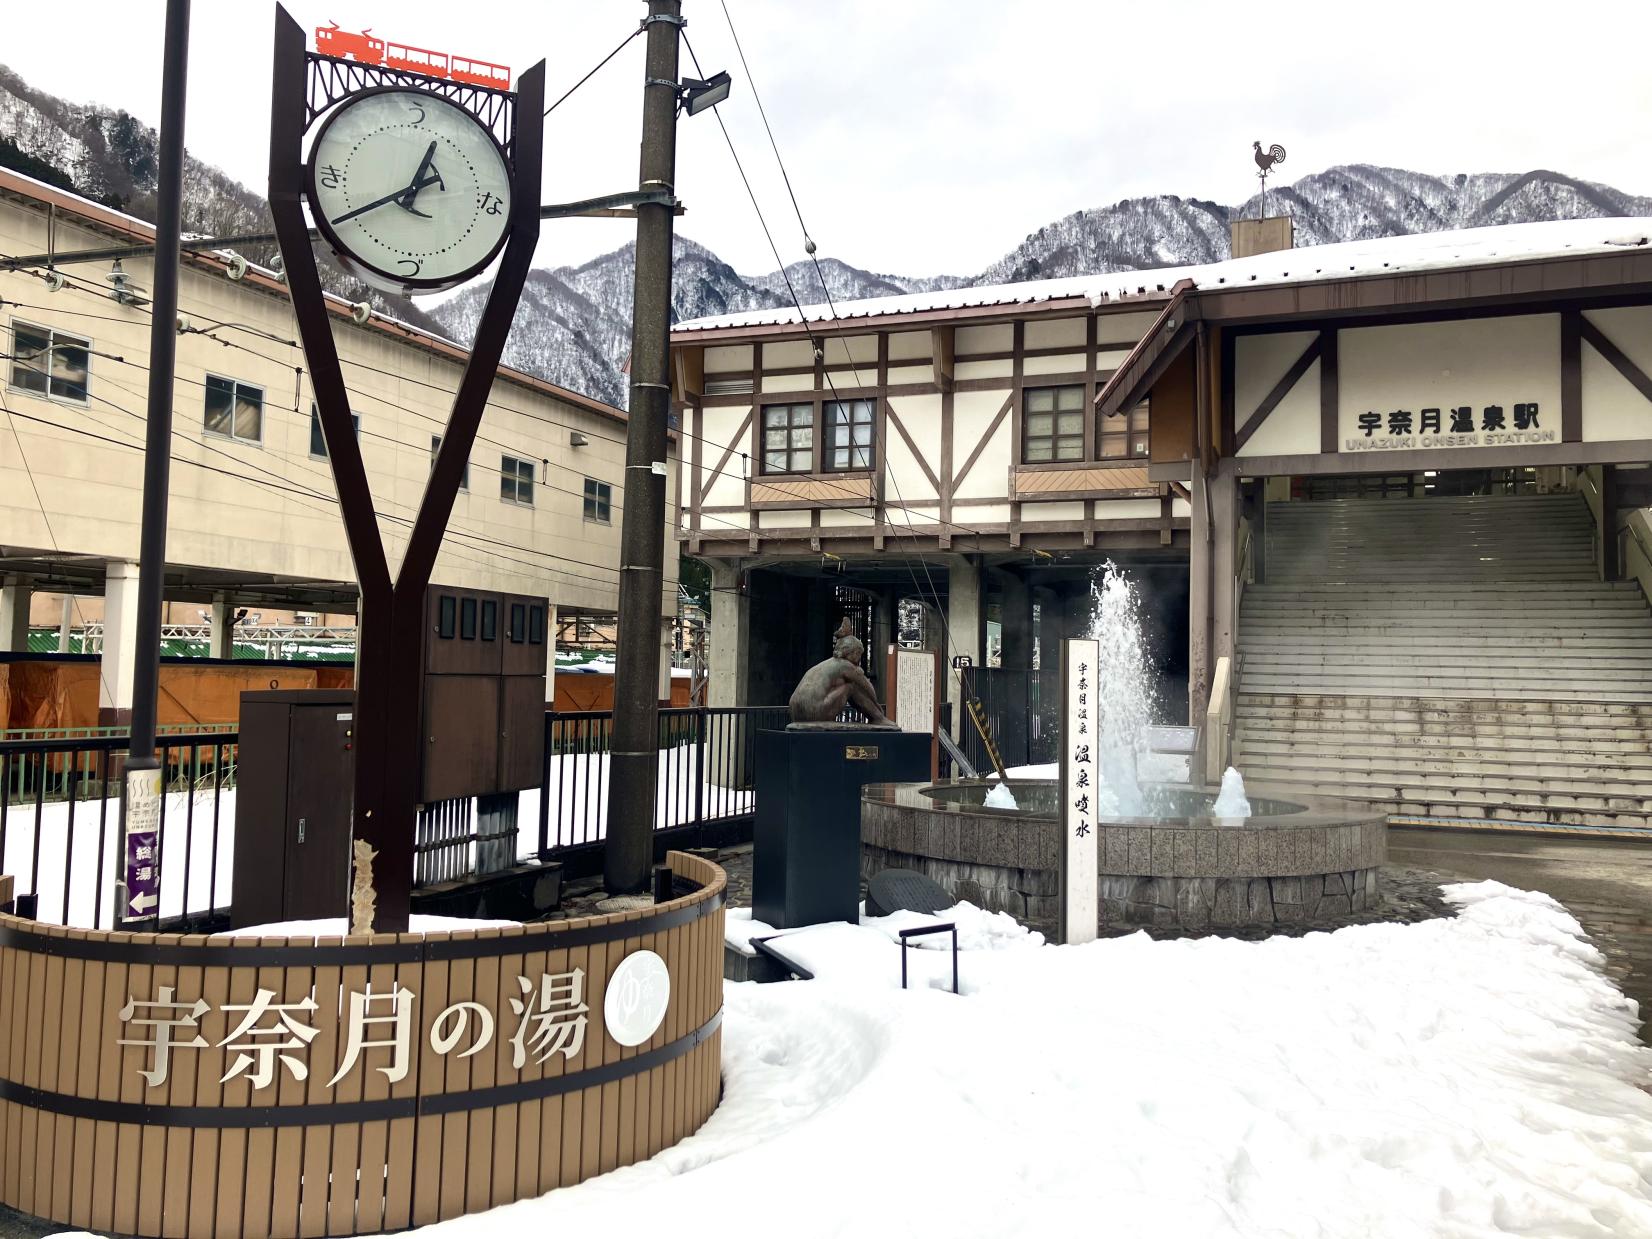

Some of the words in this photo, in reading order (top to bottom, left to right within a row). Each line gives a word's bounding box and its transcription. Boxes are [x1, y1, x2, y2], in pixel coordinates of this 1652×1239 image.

[408, 101, 426, 124] う
[481, 191, 503, 215] な
[397, 258, 423, 277] づ
[1358, 402, 1540, 437] 宇奈月温泉駅
[1346, 436, 1416, 451] UNAZUKI
[1421, 432, 1479, 448] ONSEN
[1483, 429, 1555, 445] STATION
[956, 656, 970, 668] 15
[1077, 662, 1089, 735] 宇奈月温泉
[1074, 744, 1092, 838] 温泉噴水
[135, 846, 152, 881] 総湯
[116, 967, 590, 1090] 宇奈月の湯
